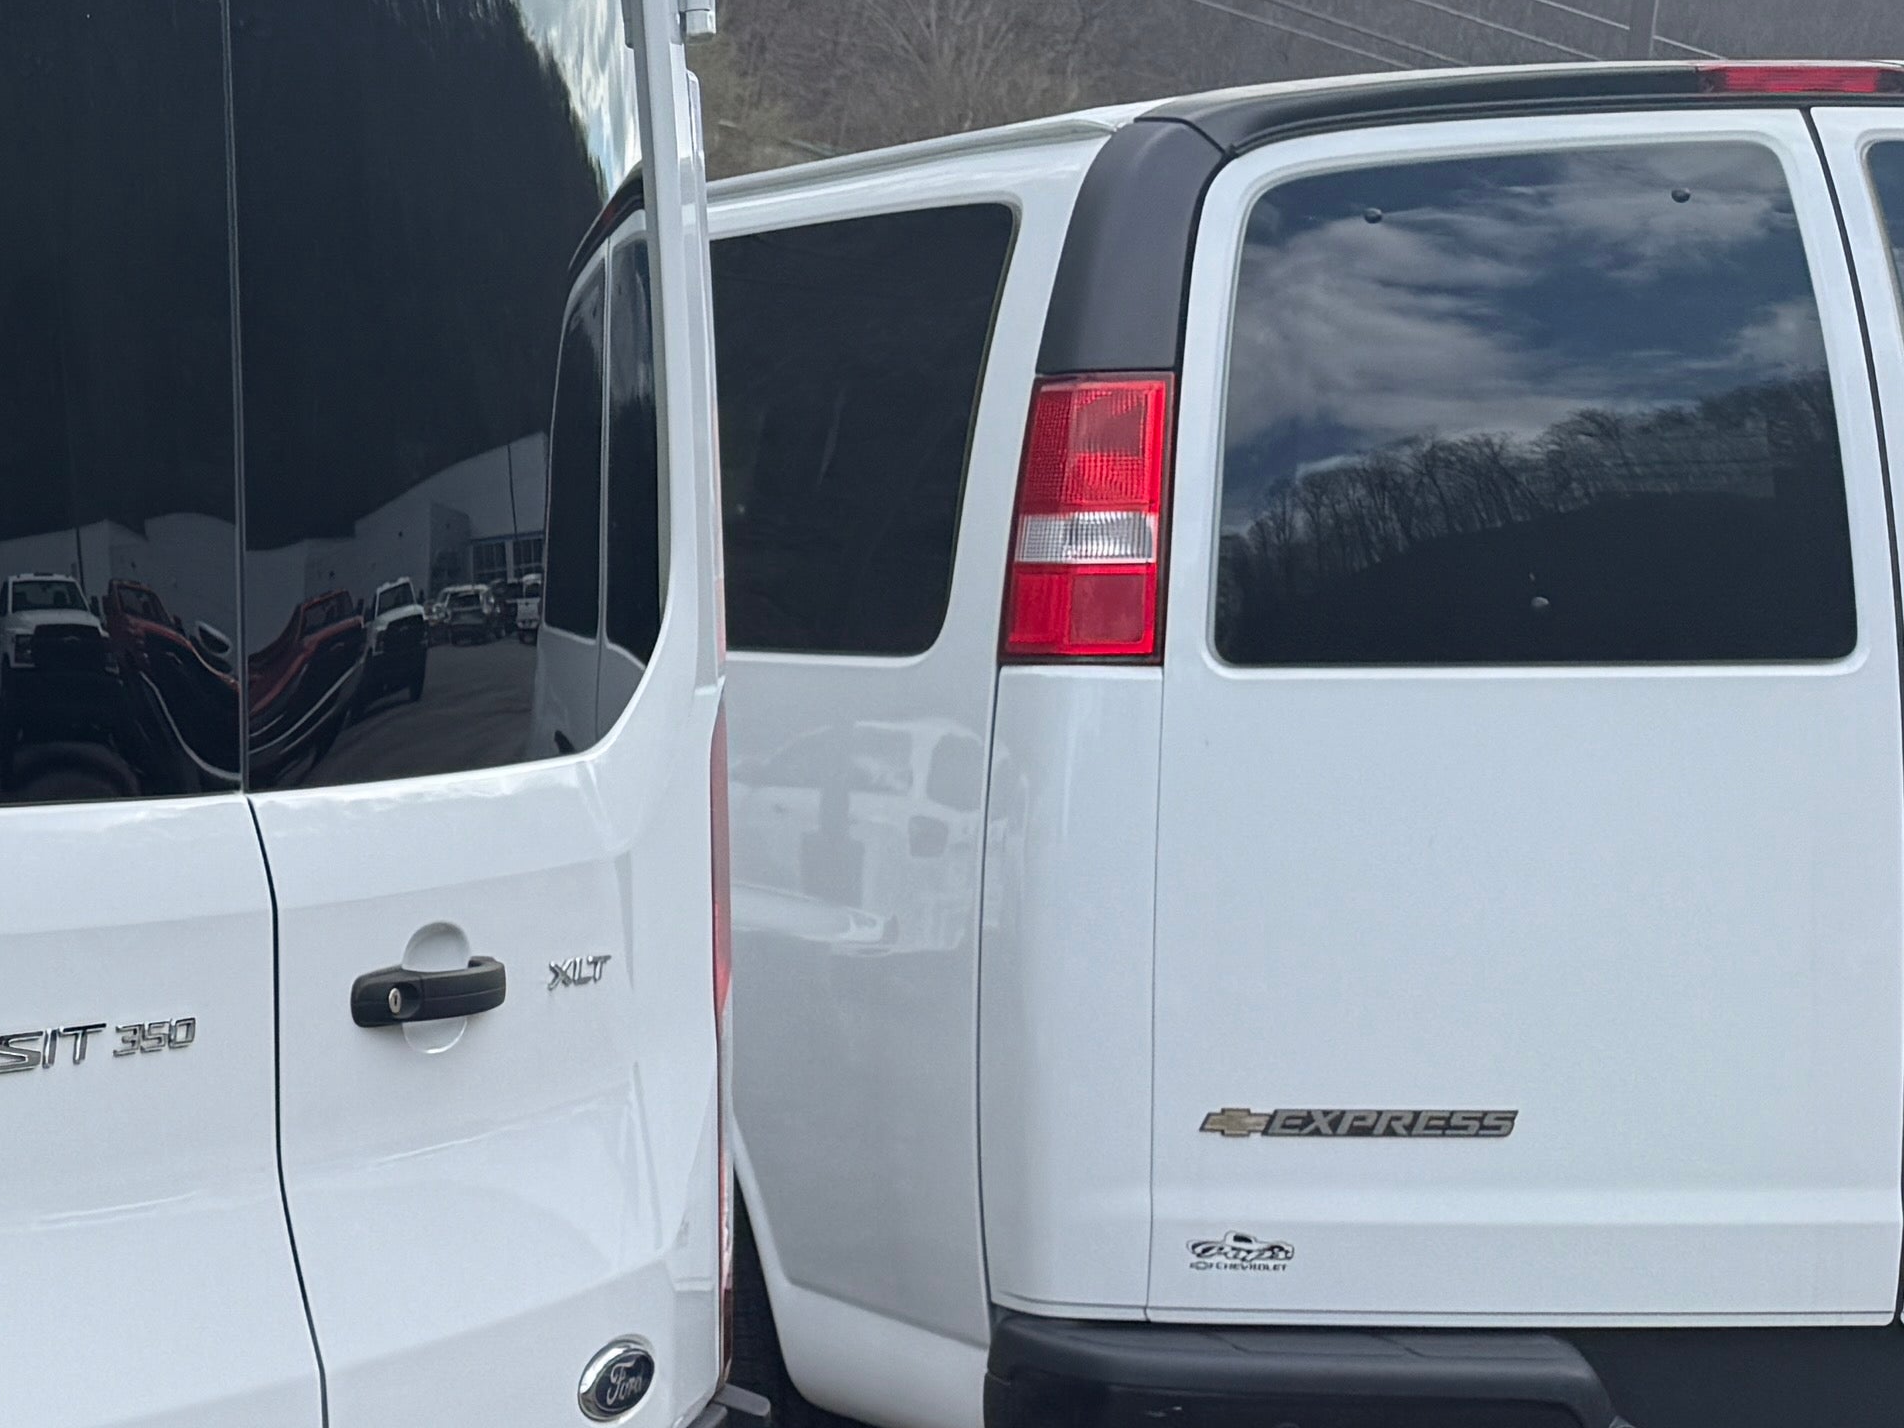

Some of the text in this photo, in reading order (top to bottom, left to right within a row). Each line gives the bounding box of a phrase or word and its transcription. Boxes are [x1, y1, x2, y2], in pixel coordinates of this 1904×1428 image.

[547, 954, 612, 991] XLT
[112, 1016, 197, 1058] 350
[1266, 1109, 1518, 1137] EXPRESS
[1215, 1261, 1287, 1271] CHEVROLET
[605, 1358, 643, 1406] Ford
